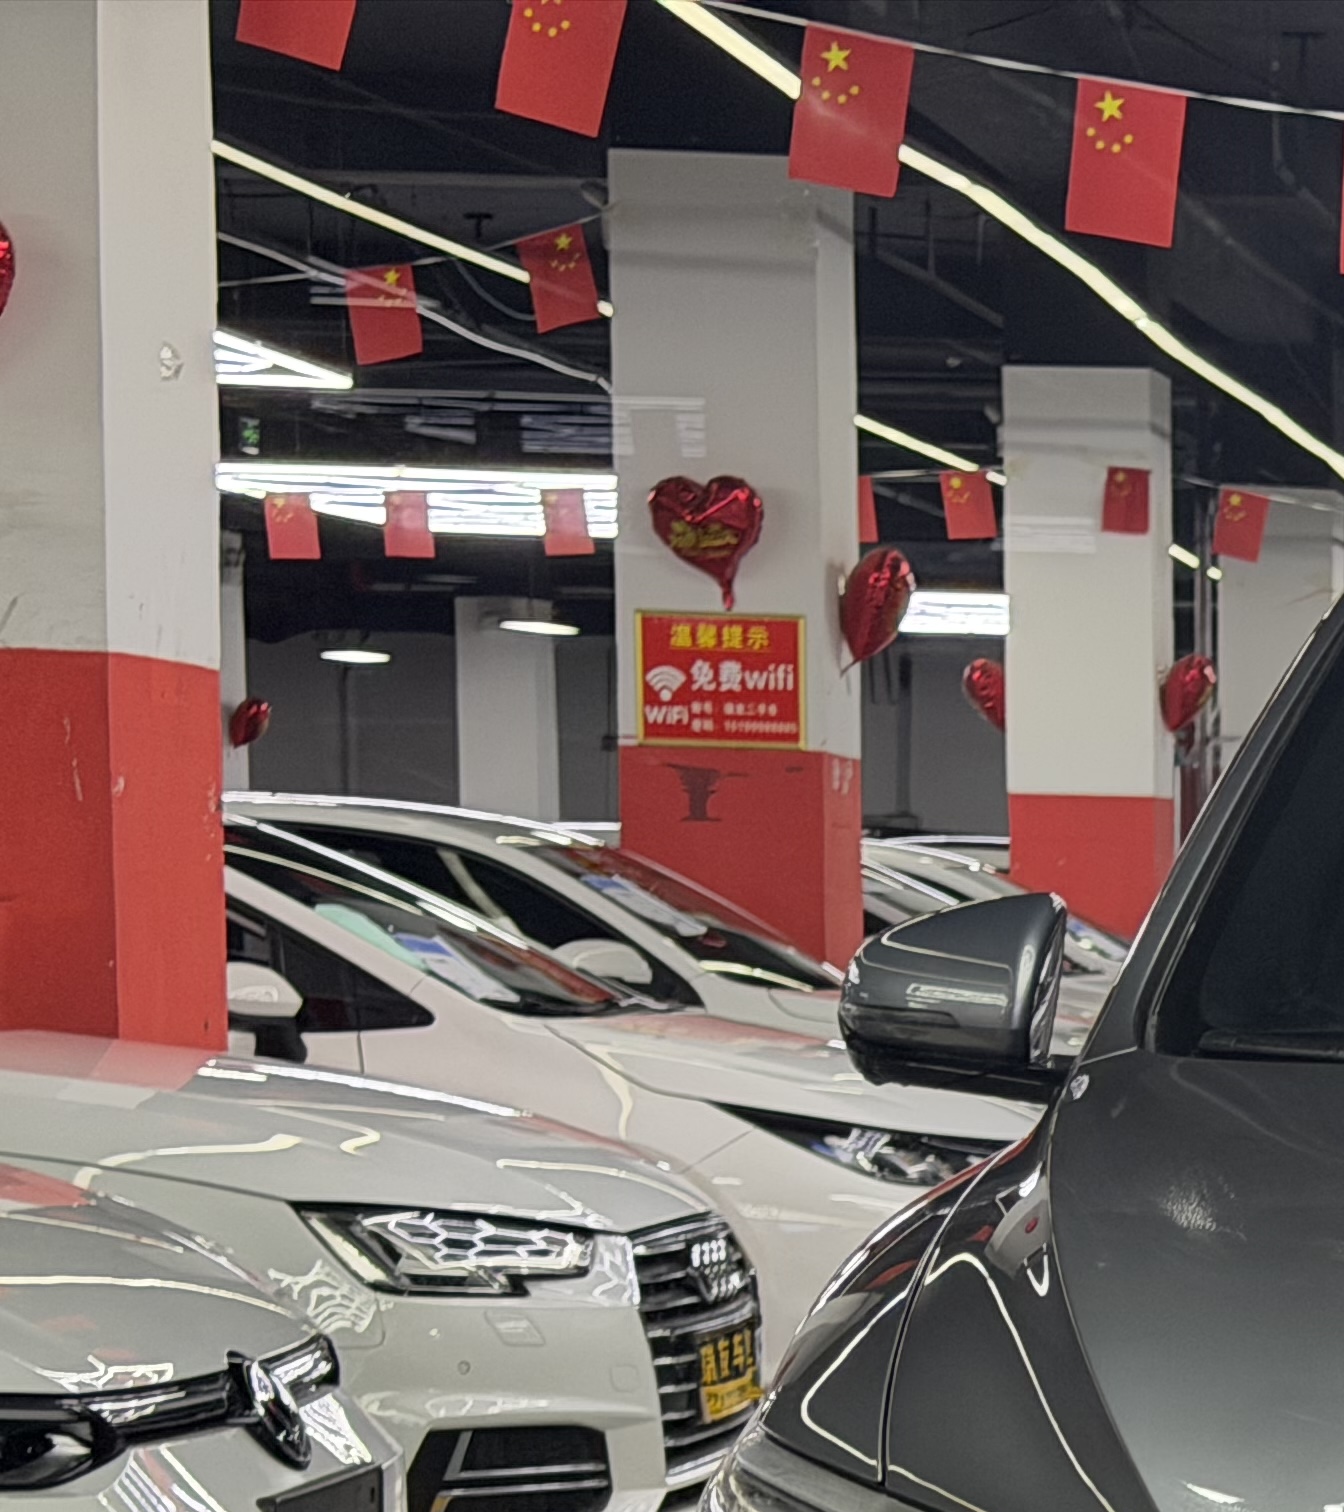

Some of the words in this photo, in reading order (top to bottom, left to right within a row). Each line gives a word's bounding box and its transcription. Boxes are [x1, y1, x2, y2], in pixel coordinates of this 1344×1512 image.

[670, 623, 769, 650] 温馨提示
[690, 659, 794, 692] 免费wifi
